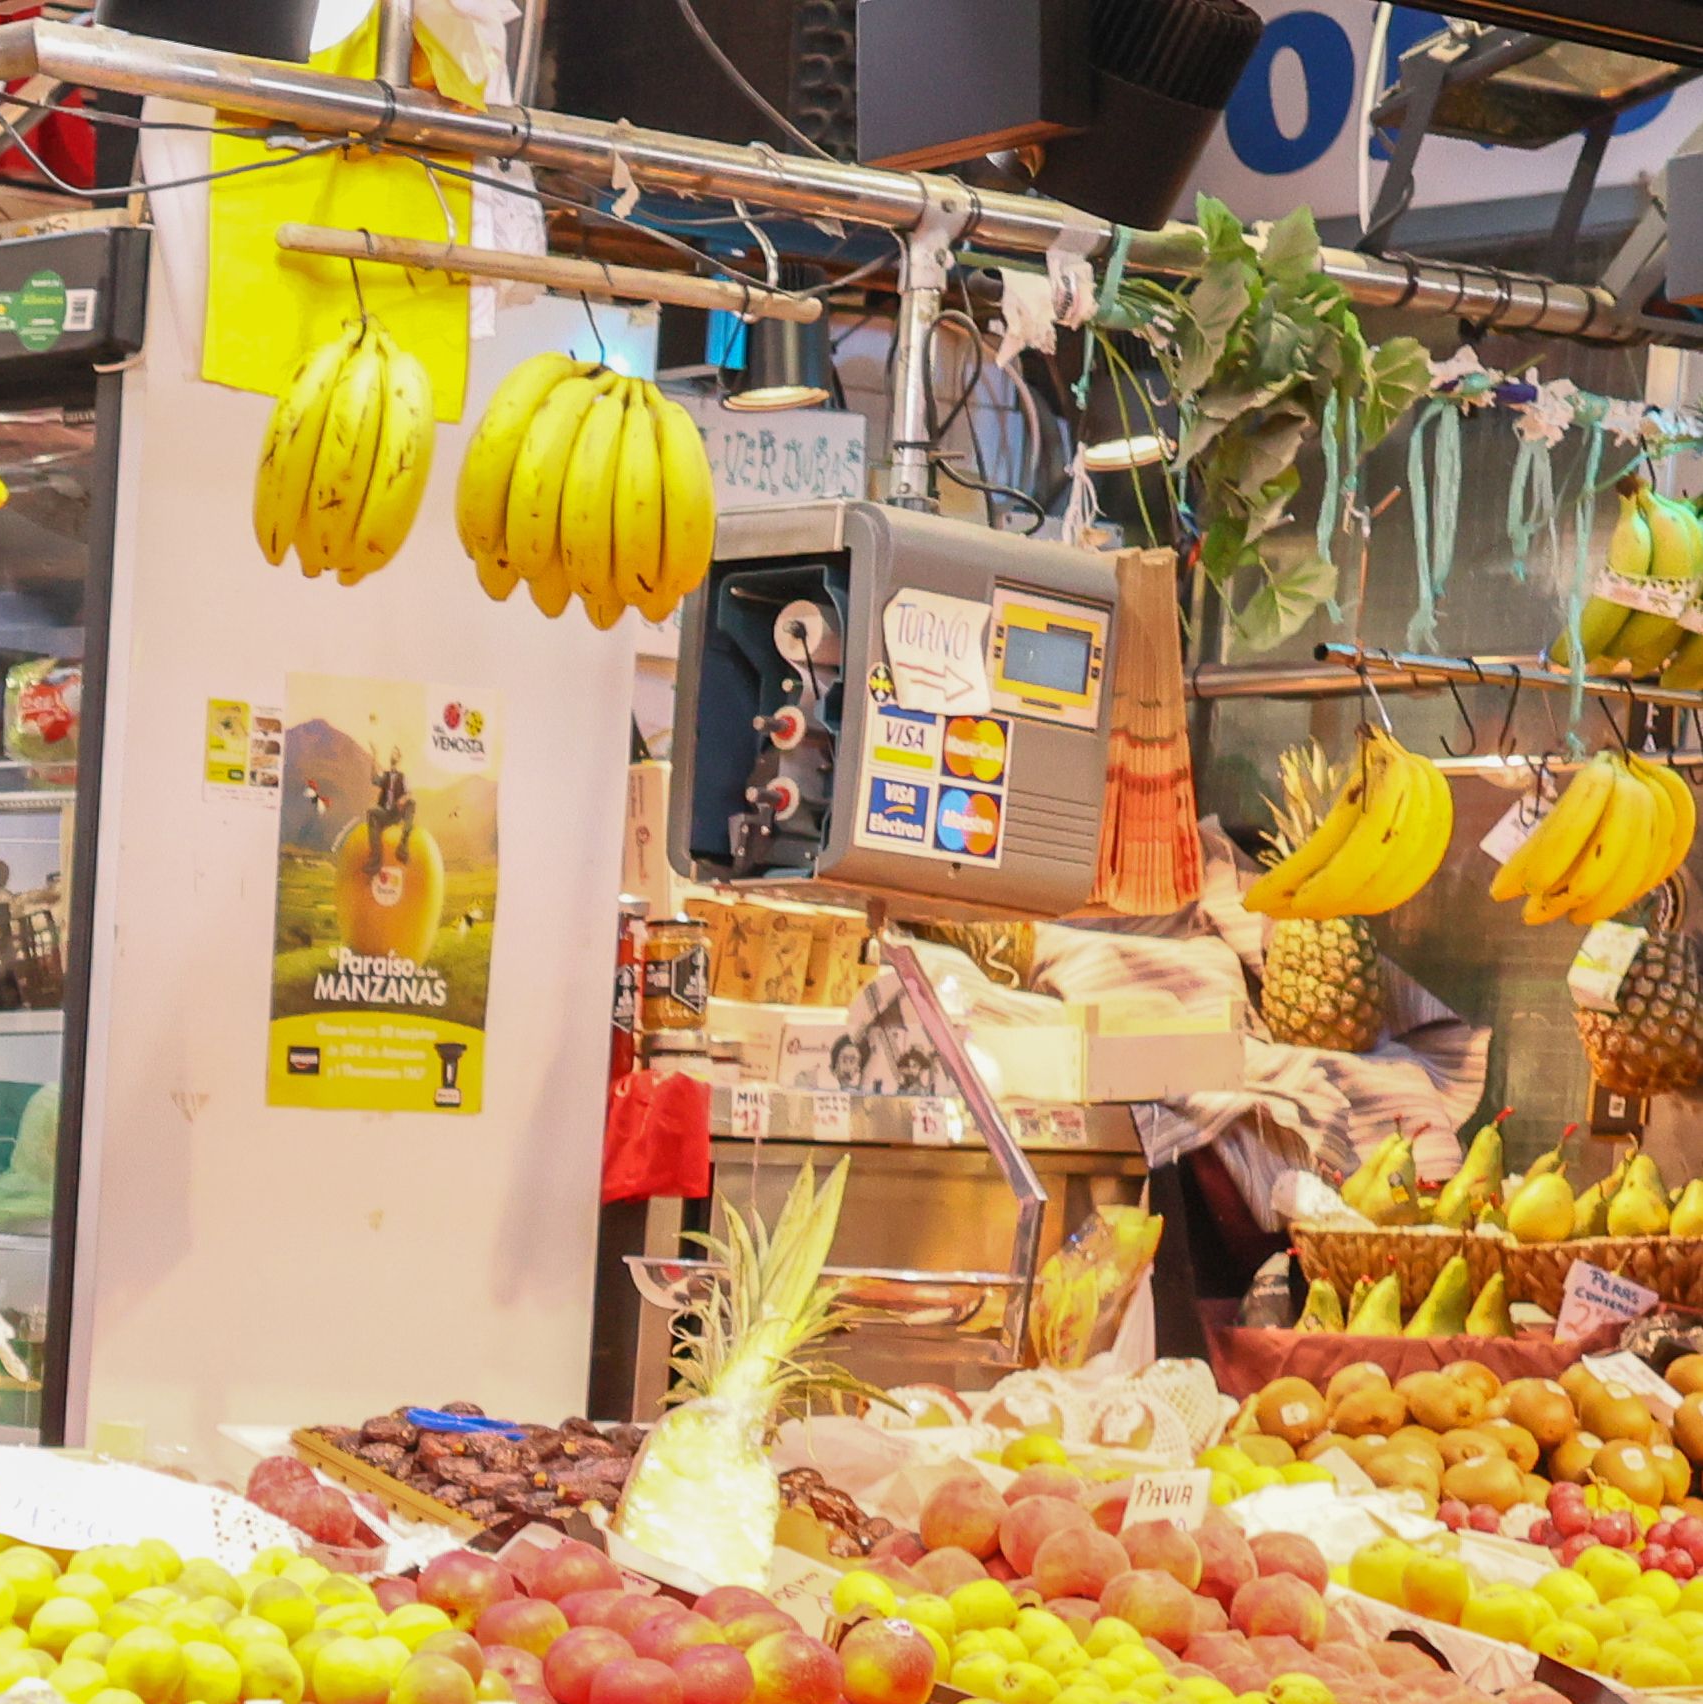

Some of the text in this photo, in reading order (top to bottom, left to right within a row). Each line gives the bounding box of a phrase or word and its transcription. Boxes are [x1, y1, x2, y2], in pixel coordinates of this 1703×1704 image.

[896, 603, 969, 660] TURNO
[885, 720, 925, 750] VISA
[884, 782, 916, 805] VISA
[869, 813, 924, 839] Electron
[942, 809, 994, 835] Maestro
[313, 972, 448, 1007] MANZANAS
[1135, 1480, 1192, 1507] PAVIA
